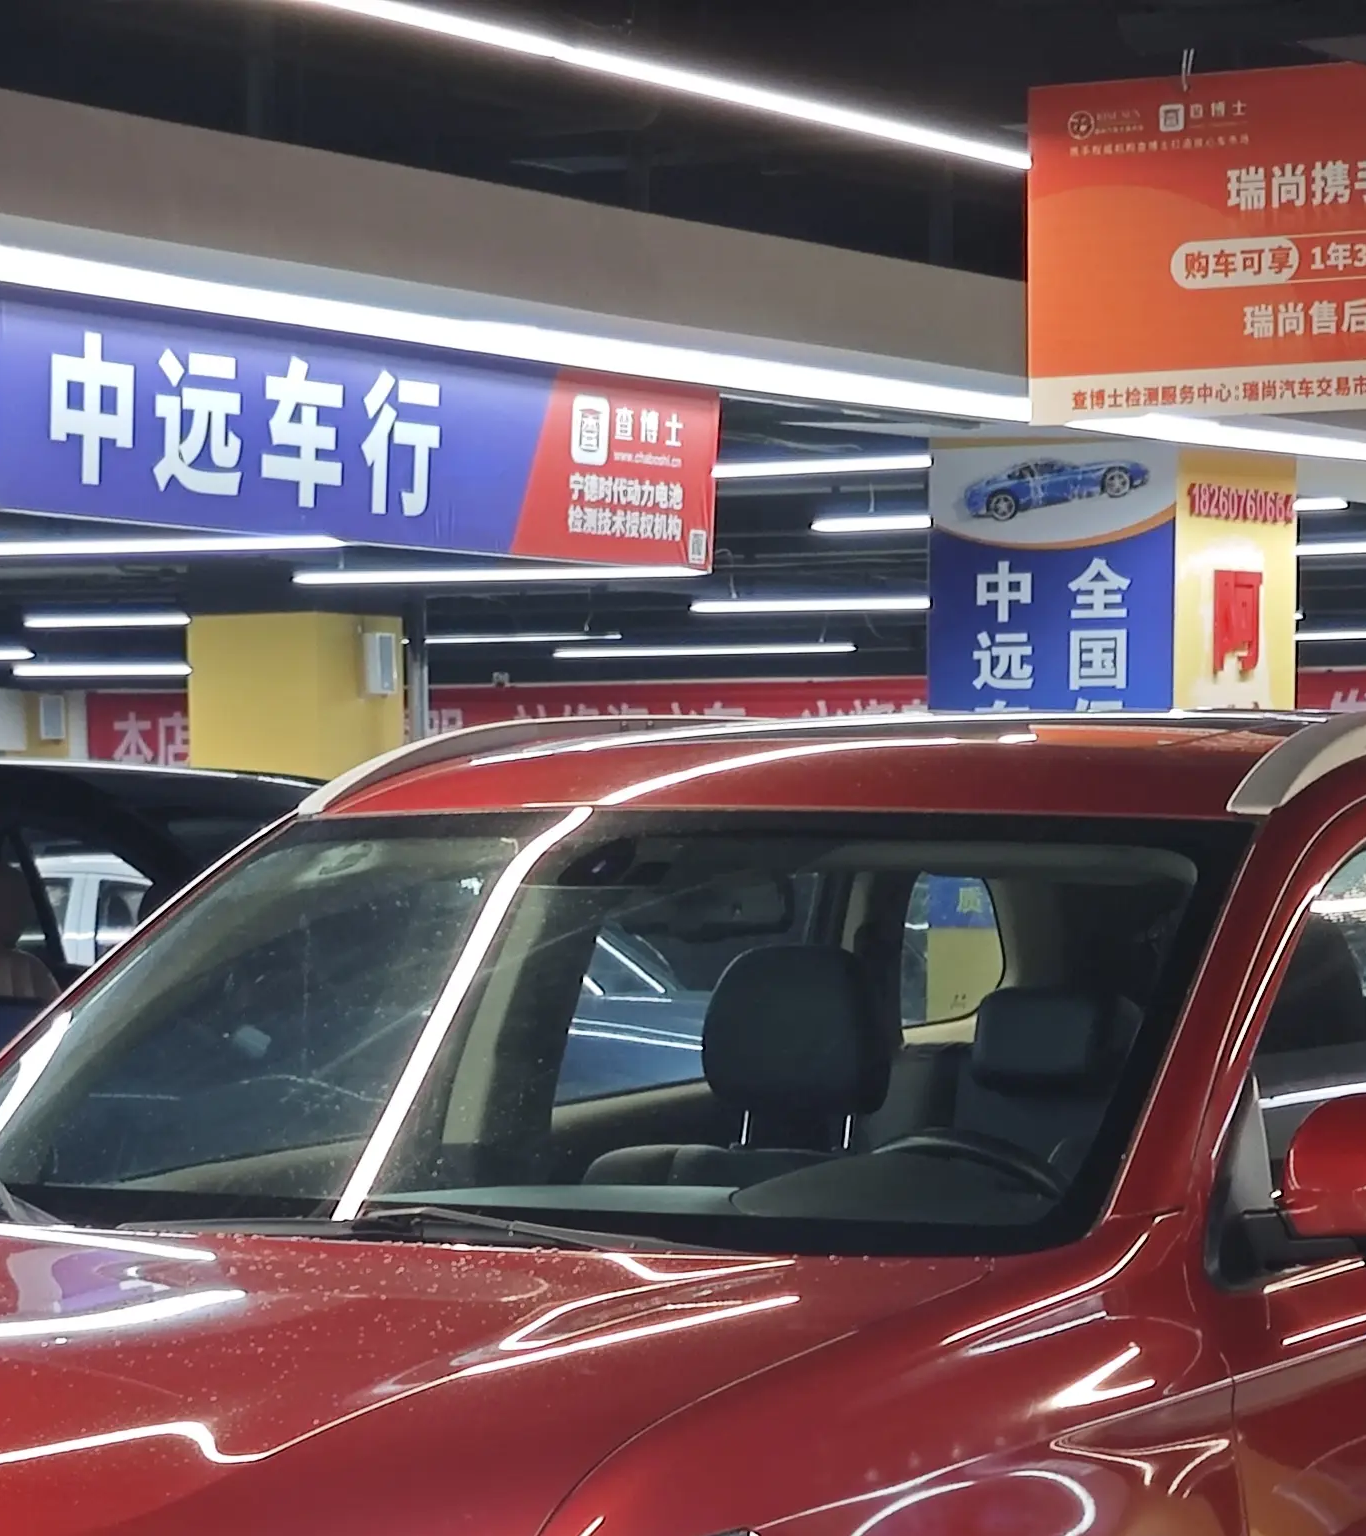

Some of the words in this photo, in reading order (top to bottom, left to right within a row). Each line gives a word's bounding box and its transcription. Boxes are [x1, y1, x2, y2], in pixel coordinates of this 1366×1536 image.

[1183, 244, 1295, 281] 购车可享
[49, 331, 441, 516] 中远车行
[615, 406, 683, 447] 查博士
[569, 472, 683, 511] 宁德时代动力电池
[568, 504, 682, 542] 检测技术授权机构
[972, 560, 1035, 711] 中远
[1068, 557, 1132, 711] 全国
